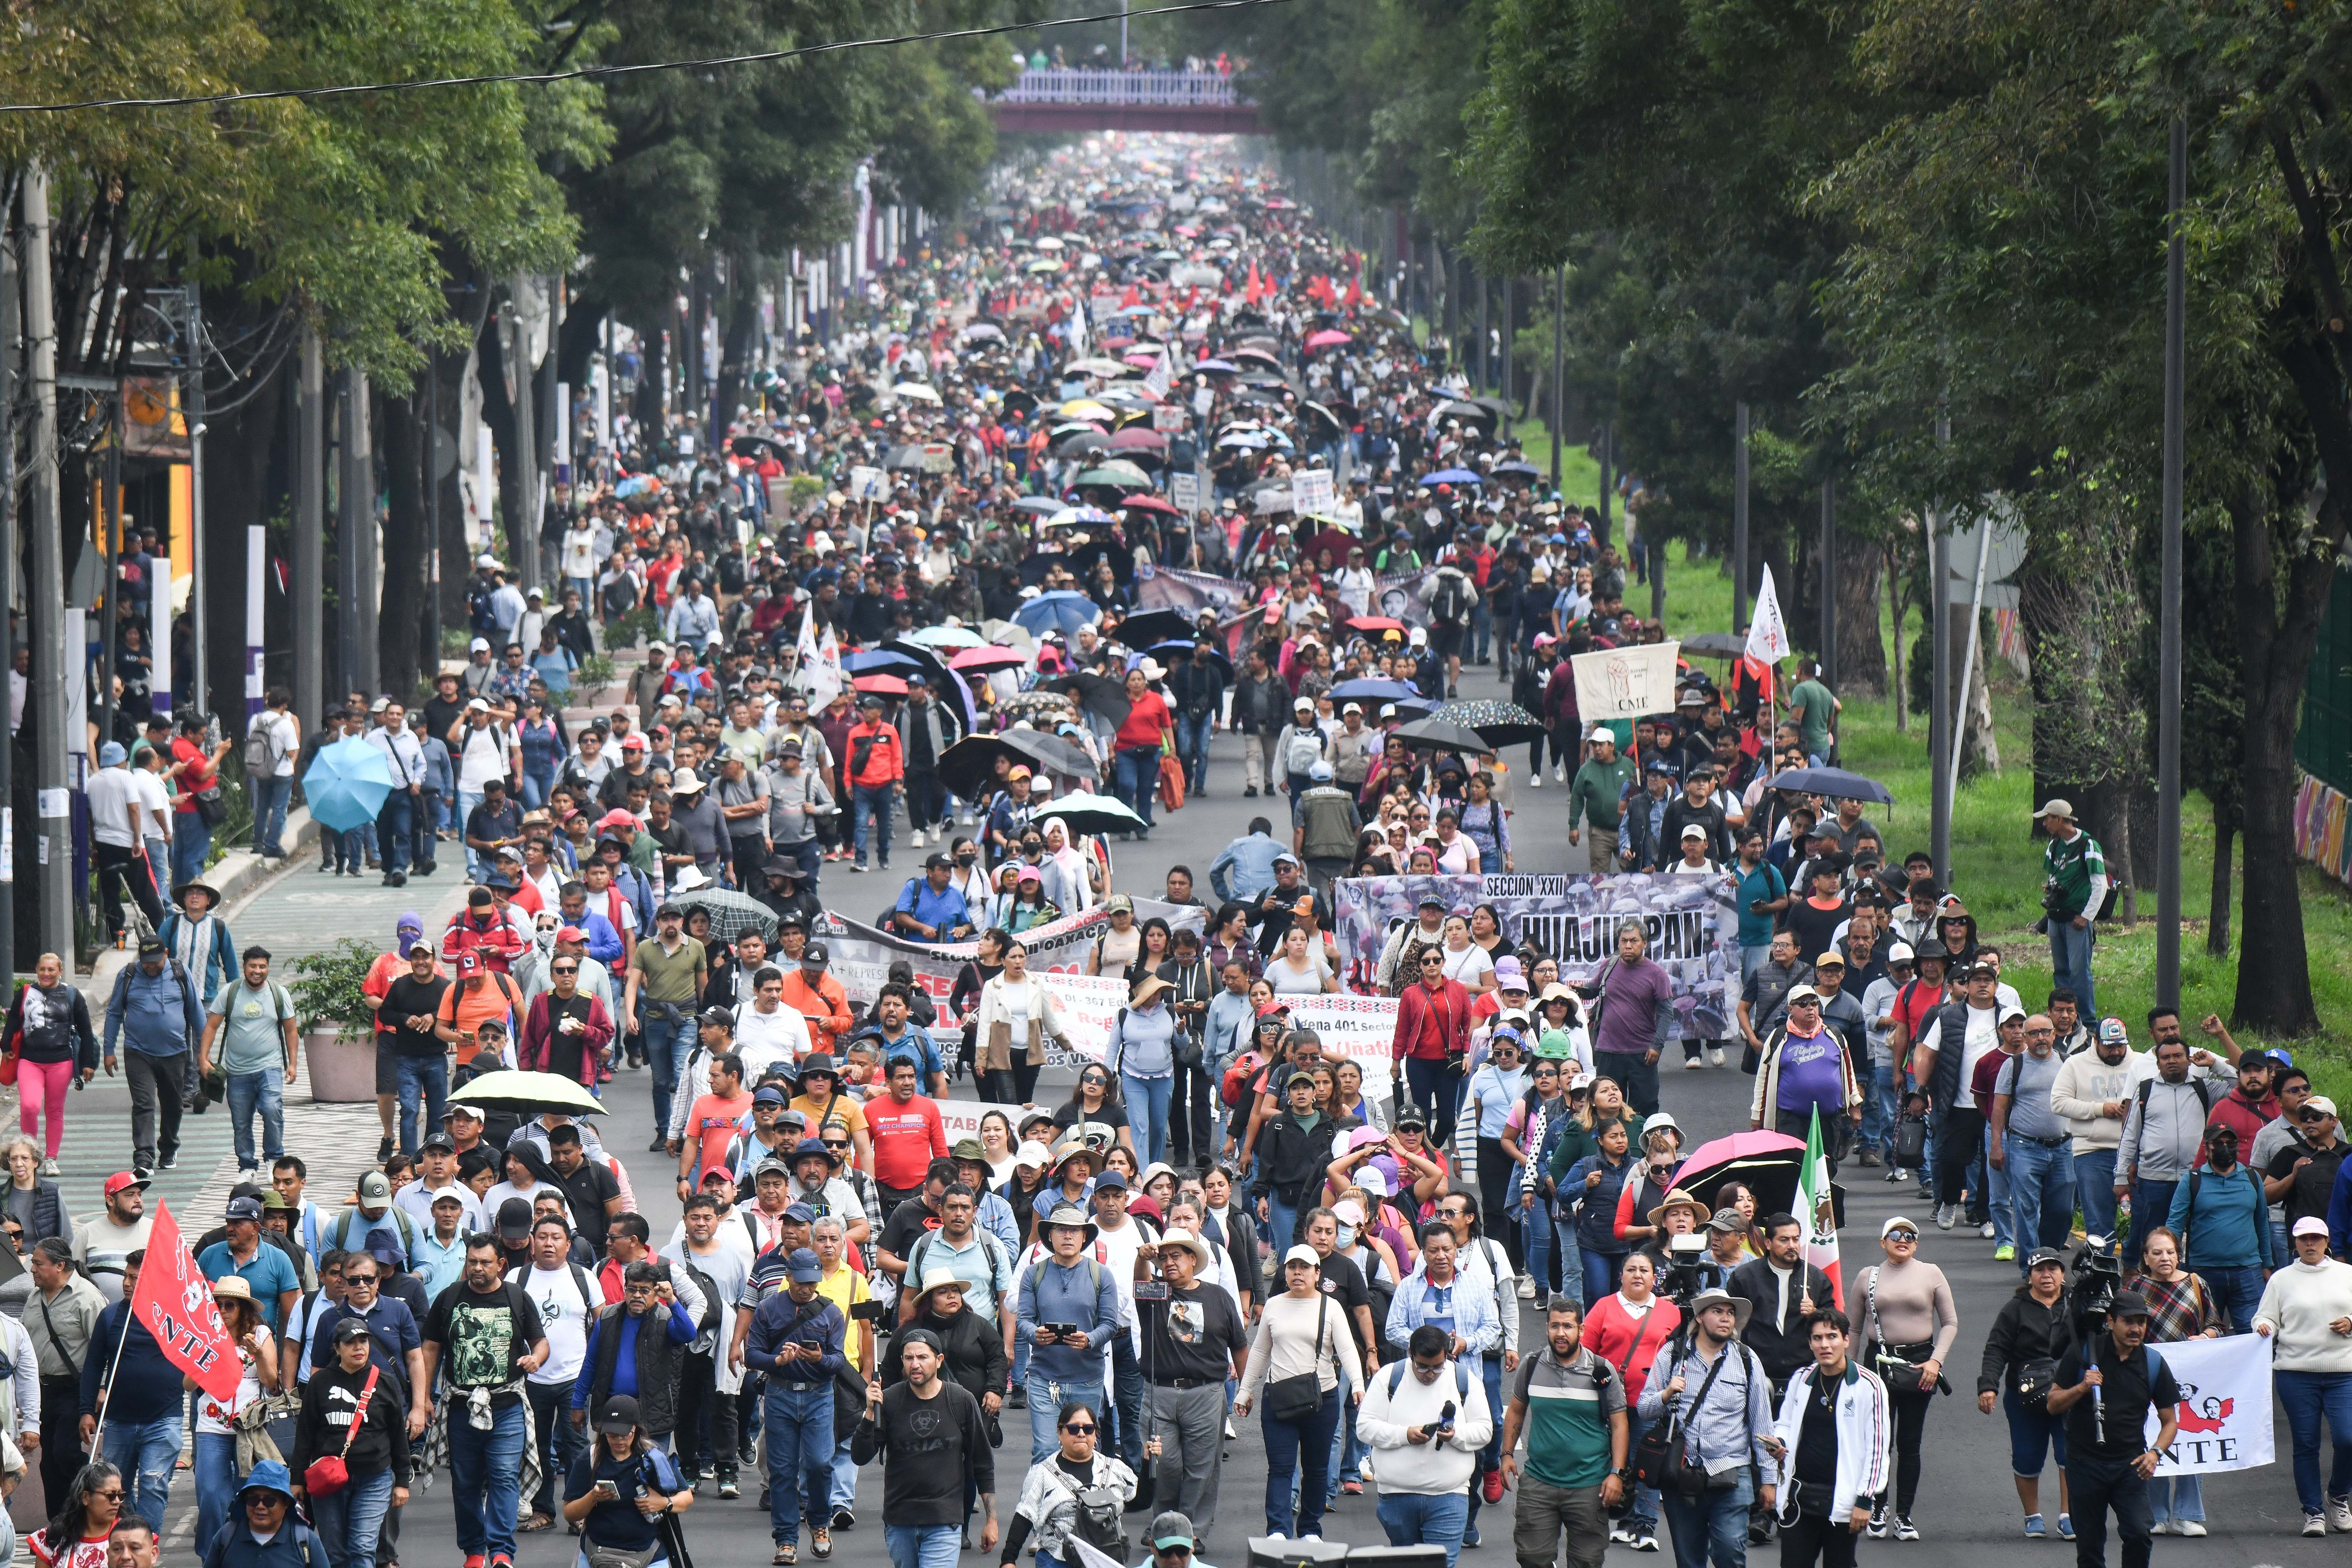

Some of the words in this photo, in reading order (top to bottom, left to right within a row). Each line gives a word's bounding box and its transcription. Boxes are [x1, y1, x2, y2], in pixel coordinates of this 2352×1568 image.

[1311, 787, 1345, 796] PRENSA
[1487, 874, 1534, 897] SECCIÓN
[1540, 878, 1563, 896] XXII
[1521, 911, 1705, 964] HUAJUPAN
[1077, 1011, 1113, 1033] Reg
[1086, 997, 1104, 1006] 367
[1301, 1019, 1331, 1032] gena
[1335, 1020, 1359, 1031] 401
[153, 1303, 219, 1372] CNTE
[2156, 1438, 2238, 1466] NTE
